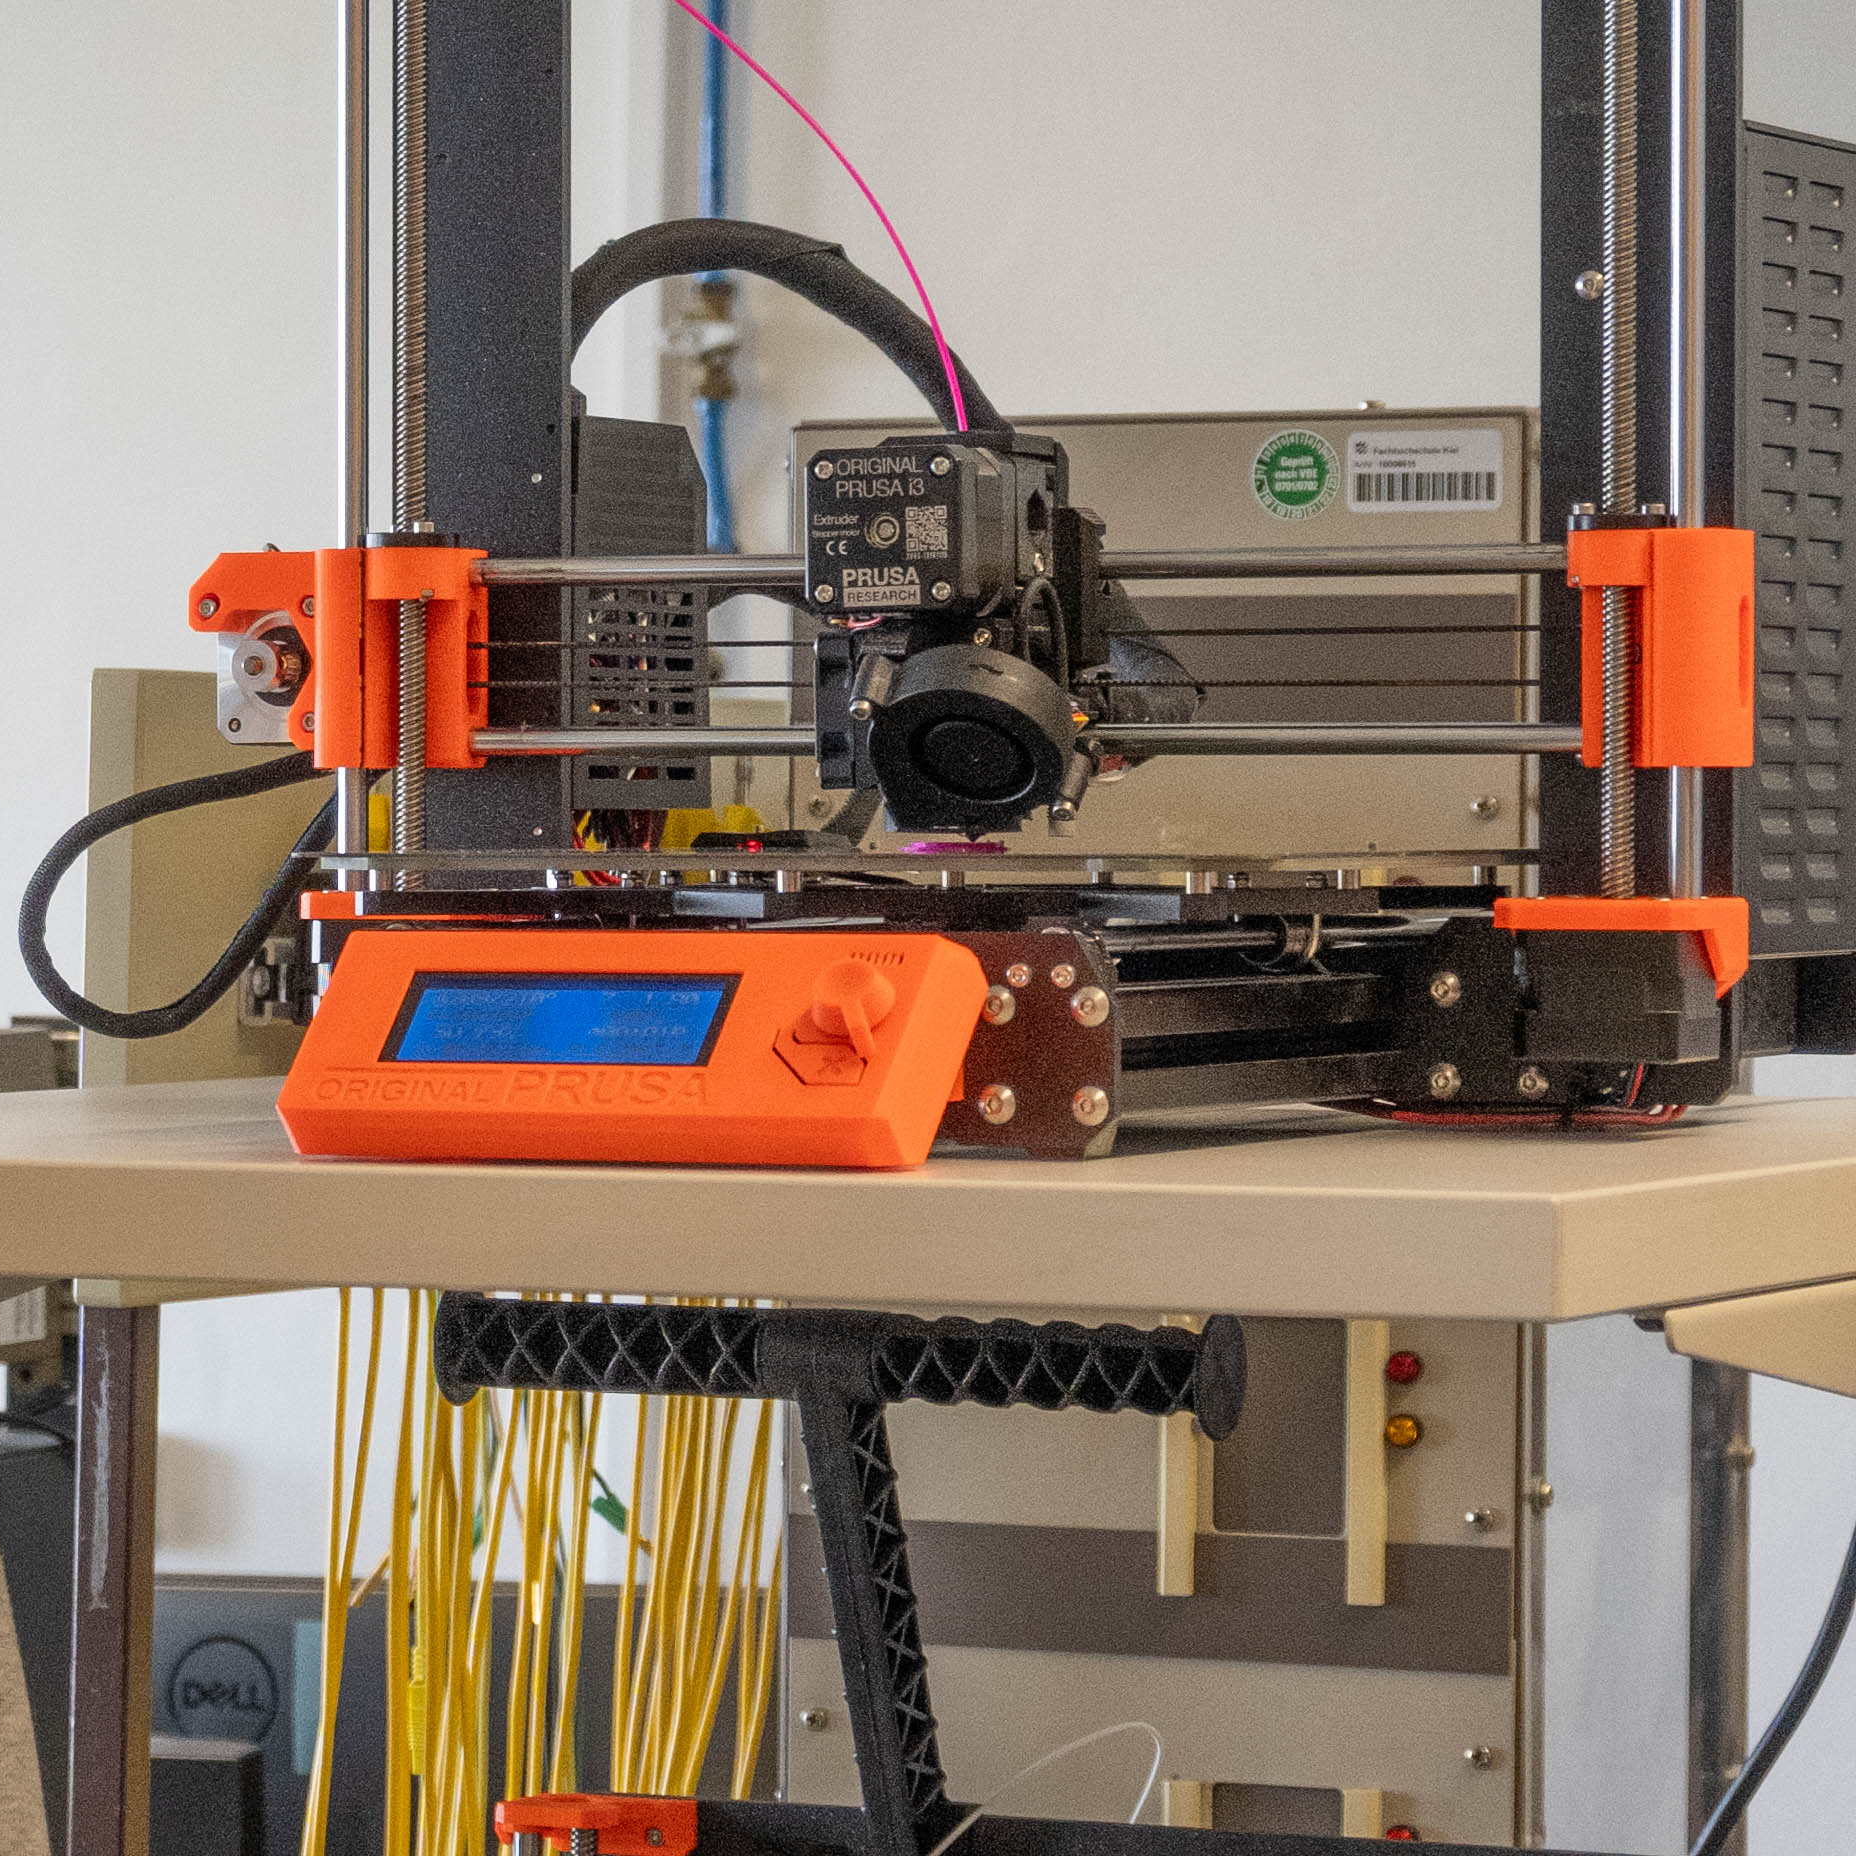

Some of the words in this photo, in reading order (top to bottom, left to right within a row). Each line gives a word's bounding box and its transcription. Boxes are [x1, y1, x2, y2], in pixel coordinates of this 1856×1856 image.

[836, 456, 923, 476] ORIGINAL
[835, 479, 904, 498] PRUSA
[909, 478, 925, 496] i3
[813, 514, 860, 526] Extruder
[842, 567, 920, 587] PRUSA
[847, 590, 916, 603] RESEARCH
[315, 1077, 491, 1104] ORIGINAL
[504, 1069, 710, 1106] PRUSA
[183, 1677, 267, 1712] DELL
